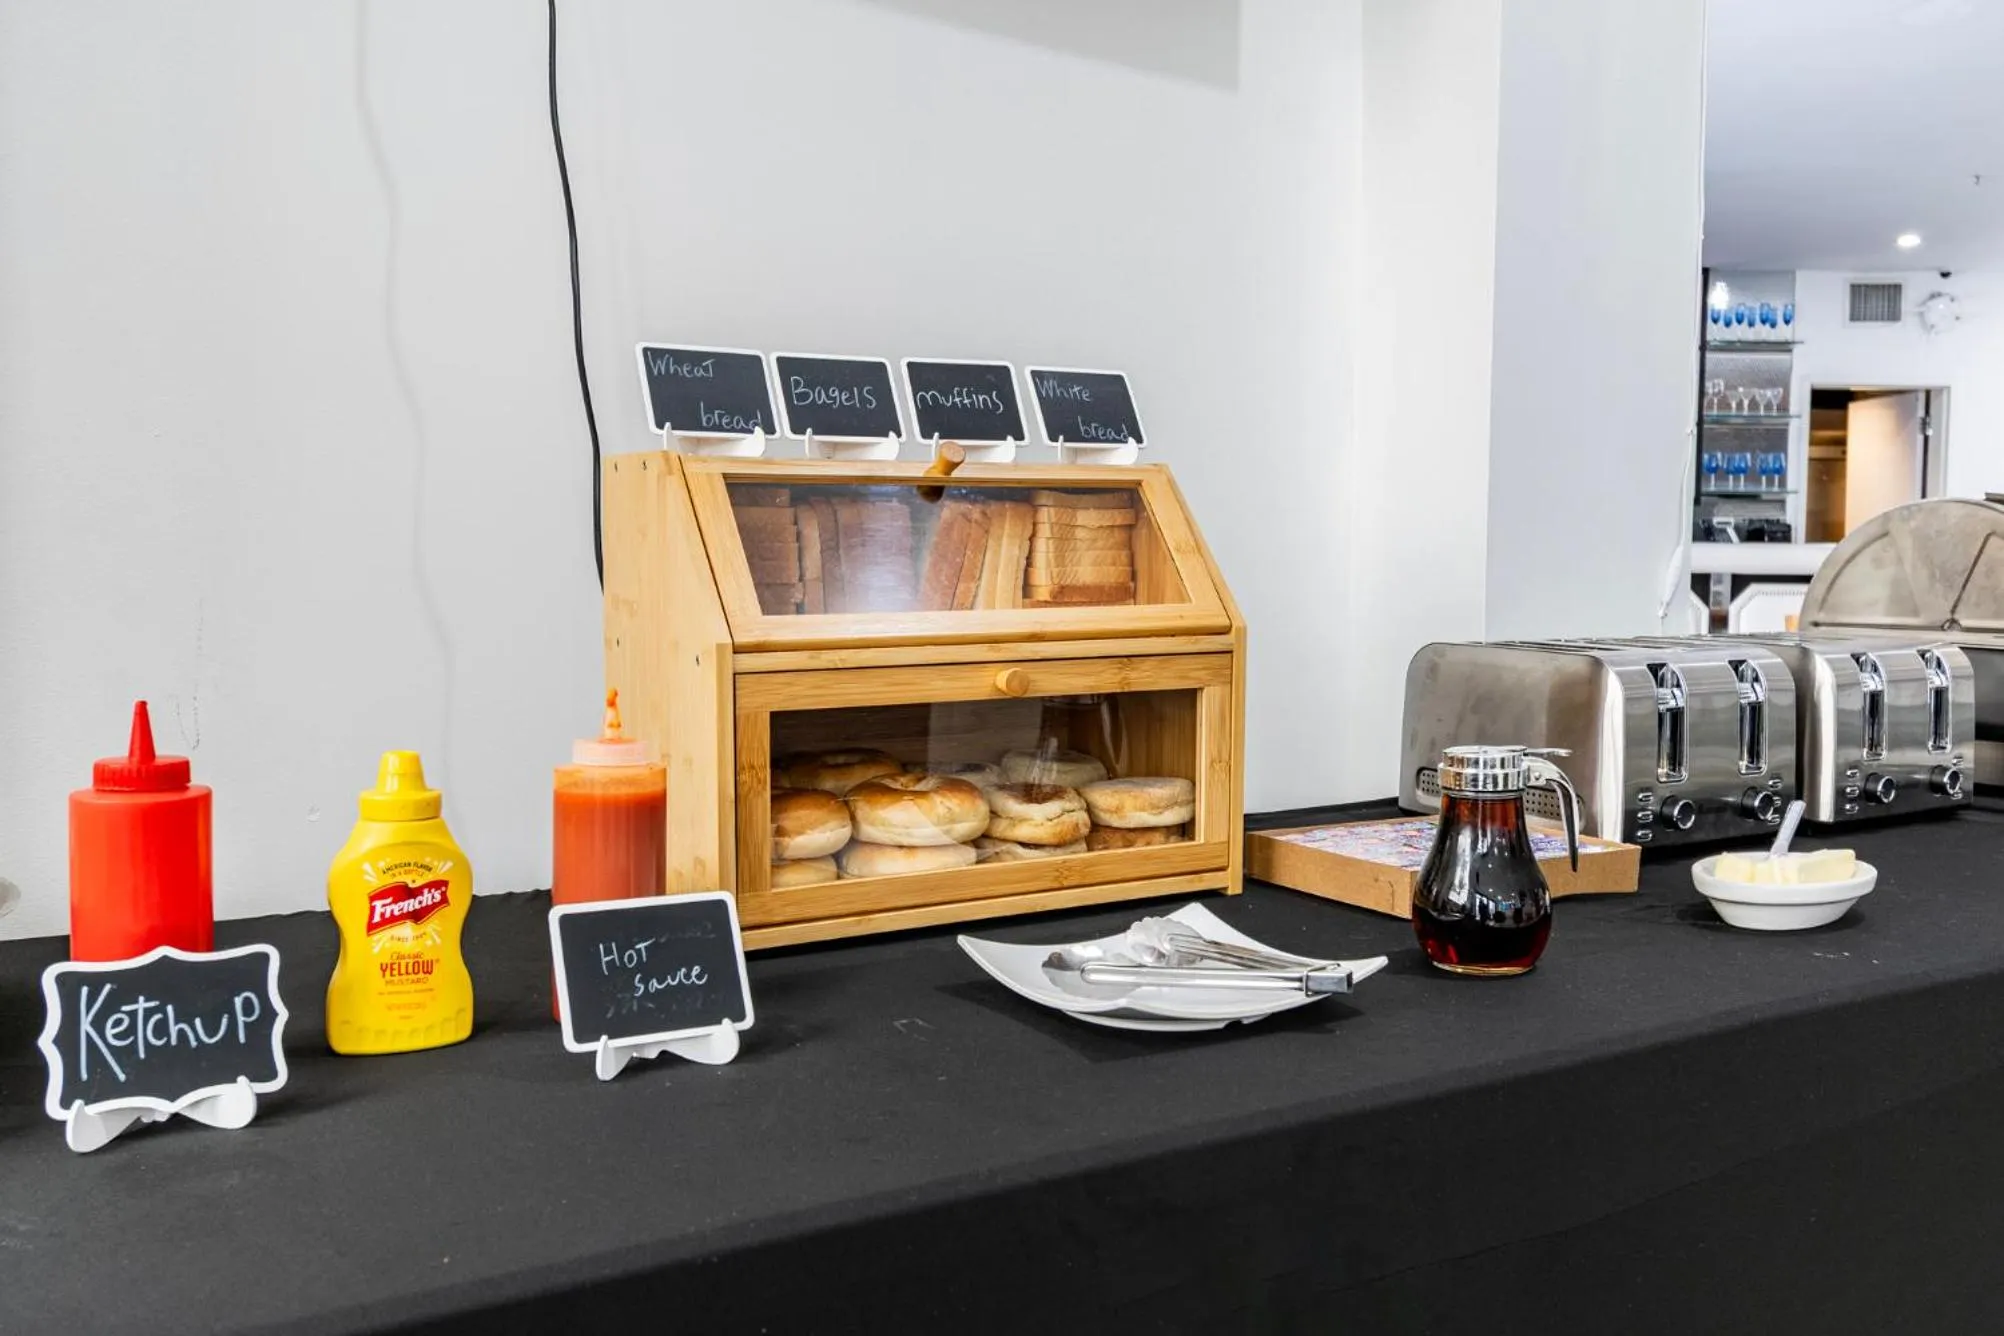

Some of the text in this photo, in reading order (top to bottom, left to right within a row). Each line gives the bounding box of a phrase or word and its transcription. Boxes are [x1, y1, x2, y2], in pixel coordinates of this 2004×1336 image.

[789, 375, 877, 409] Bagels
[915, 386, 1004, 414] muffins
[1035, 377, 1092, 402] White
[699, 401, 762, 431] bread
[1077, 415, 1129, 442] bread
[371, 887, 442, 924] French's
[379, 958, 434, 979] YELLOW
[633, 965, 709, 997] sauce
[79, 983, 261, 1083] Ketchup
